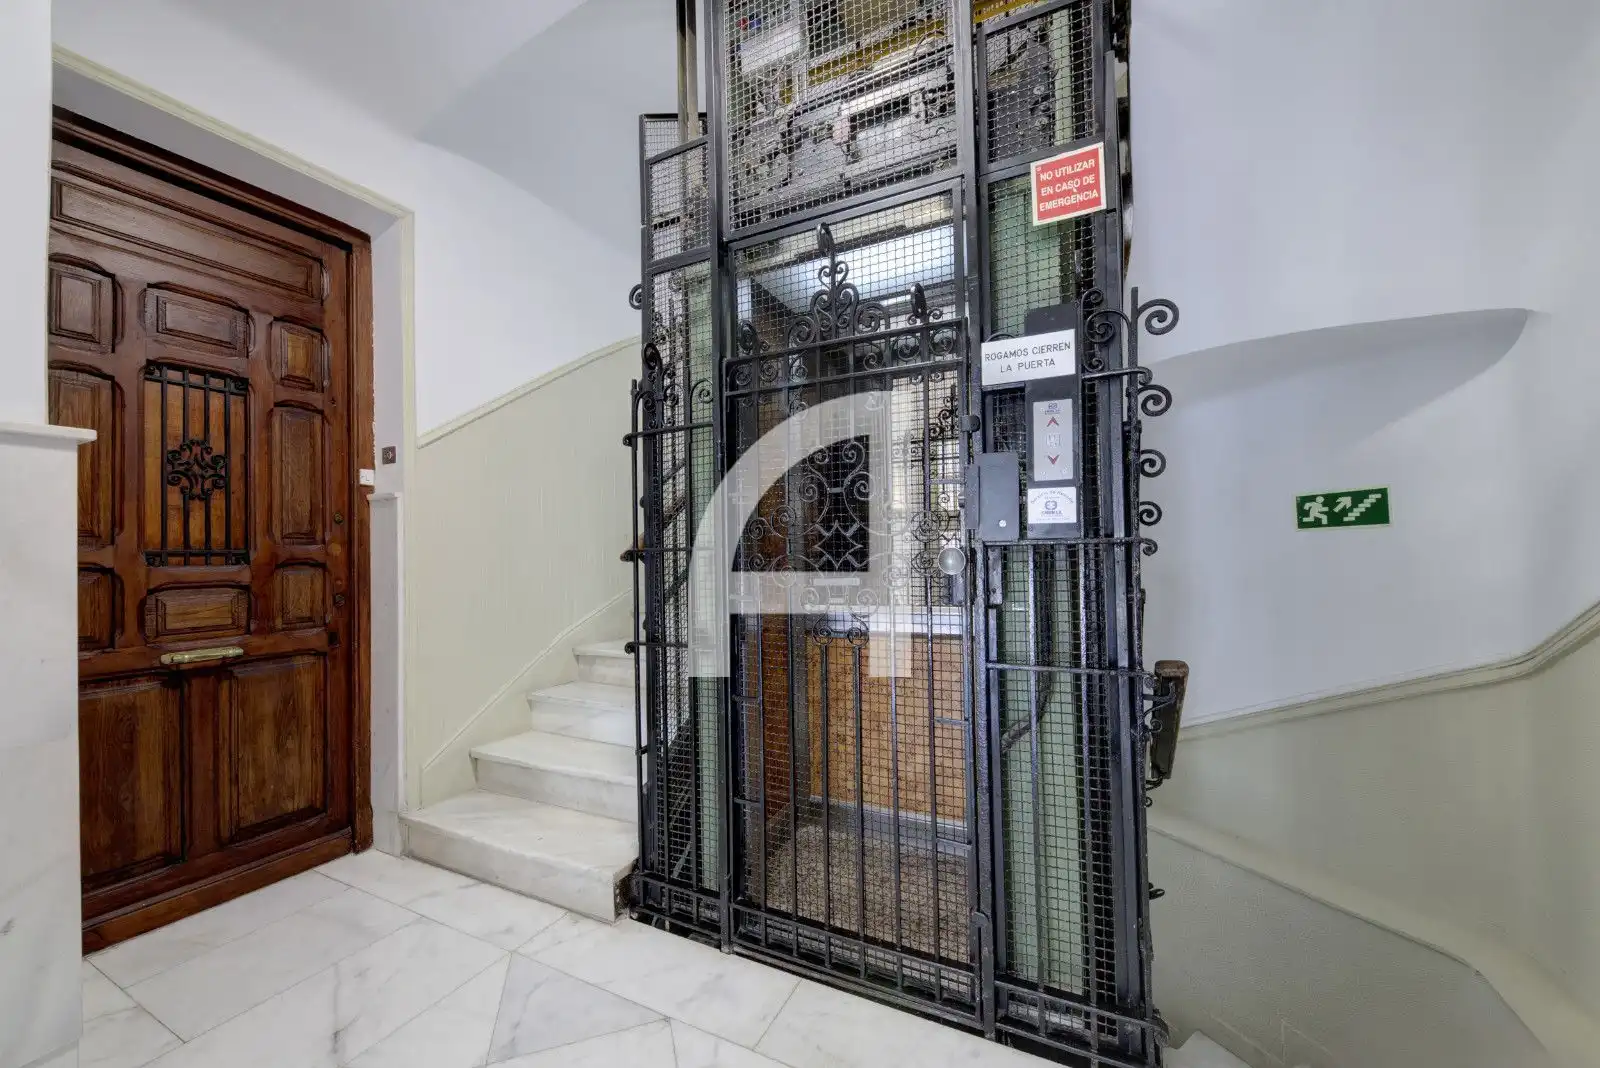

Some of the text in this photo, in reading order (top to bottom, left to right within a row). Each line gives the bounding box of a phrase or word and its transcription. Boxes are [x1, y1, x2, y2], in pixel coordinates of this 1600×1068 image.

[1040, 159, 1096, 182] NO UTILIZAR
[1041, 174, 1096, 196] EN CASO DE
[1039, 189, 1099, 211] EMERGENCIA
[985, 341, 1071, 361] ROGAMOS CIERREN
[1000, 358, 1056, 373] LA PUERTA
